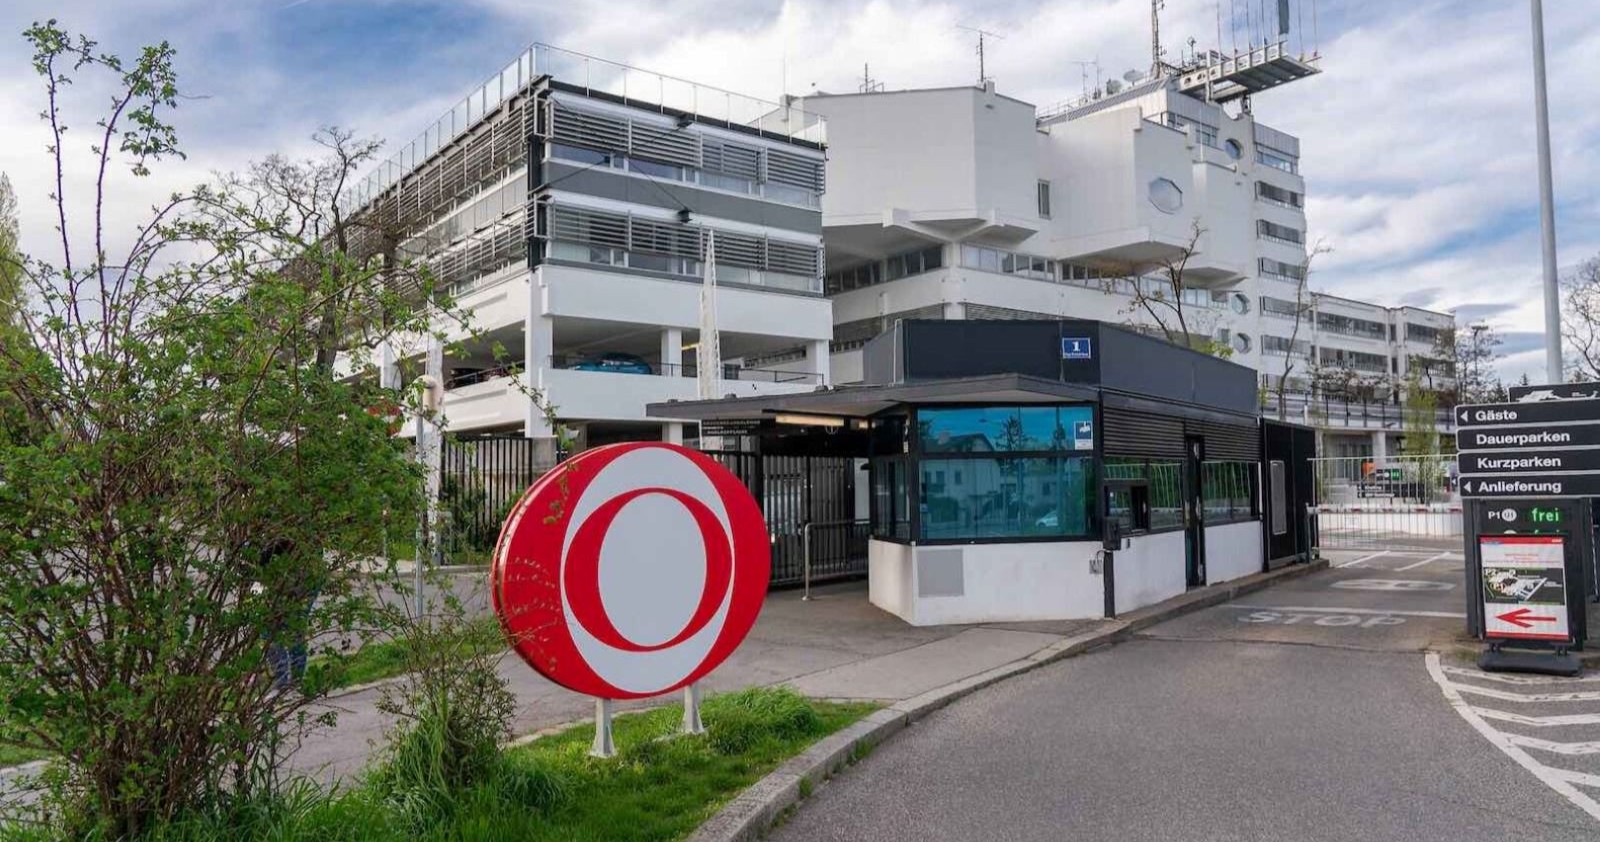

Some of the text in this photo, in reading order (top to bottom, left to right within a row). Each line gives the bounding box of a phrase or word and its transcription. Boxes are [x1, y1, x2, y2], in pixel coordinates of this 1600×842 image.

[1072, 341, 1081, 352] 1
[1475, 409, 1518, 422] Gäste
[1476, 431, 1571, 446] Dauerparken
[1477, 456, 1562, 470] Kurzparken
[1478, 481, 1562, 494] Anlieferung
[1531, 507, 1560, 521] frei
[1238, 611, 1407, 628] STOP
